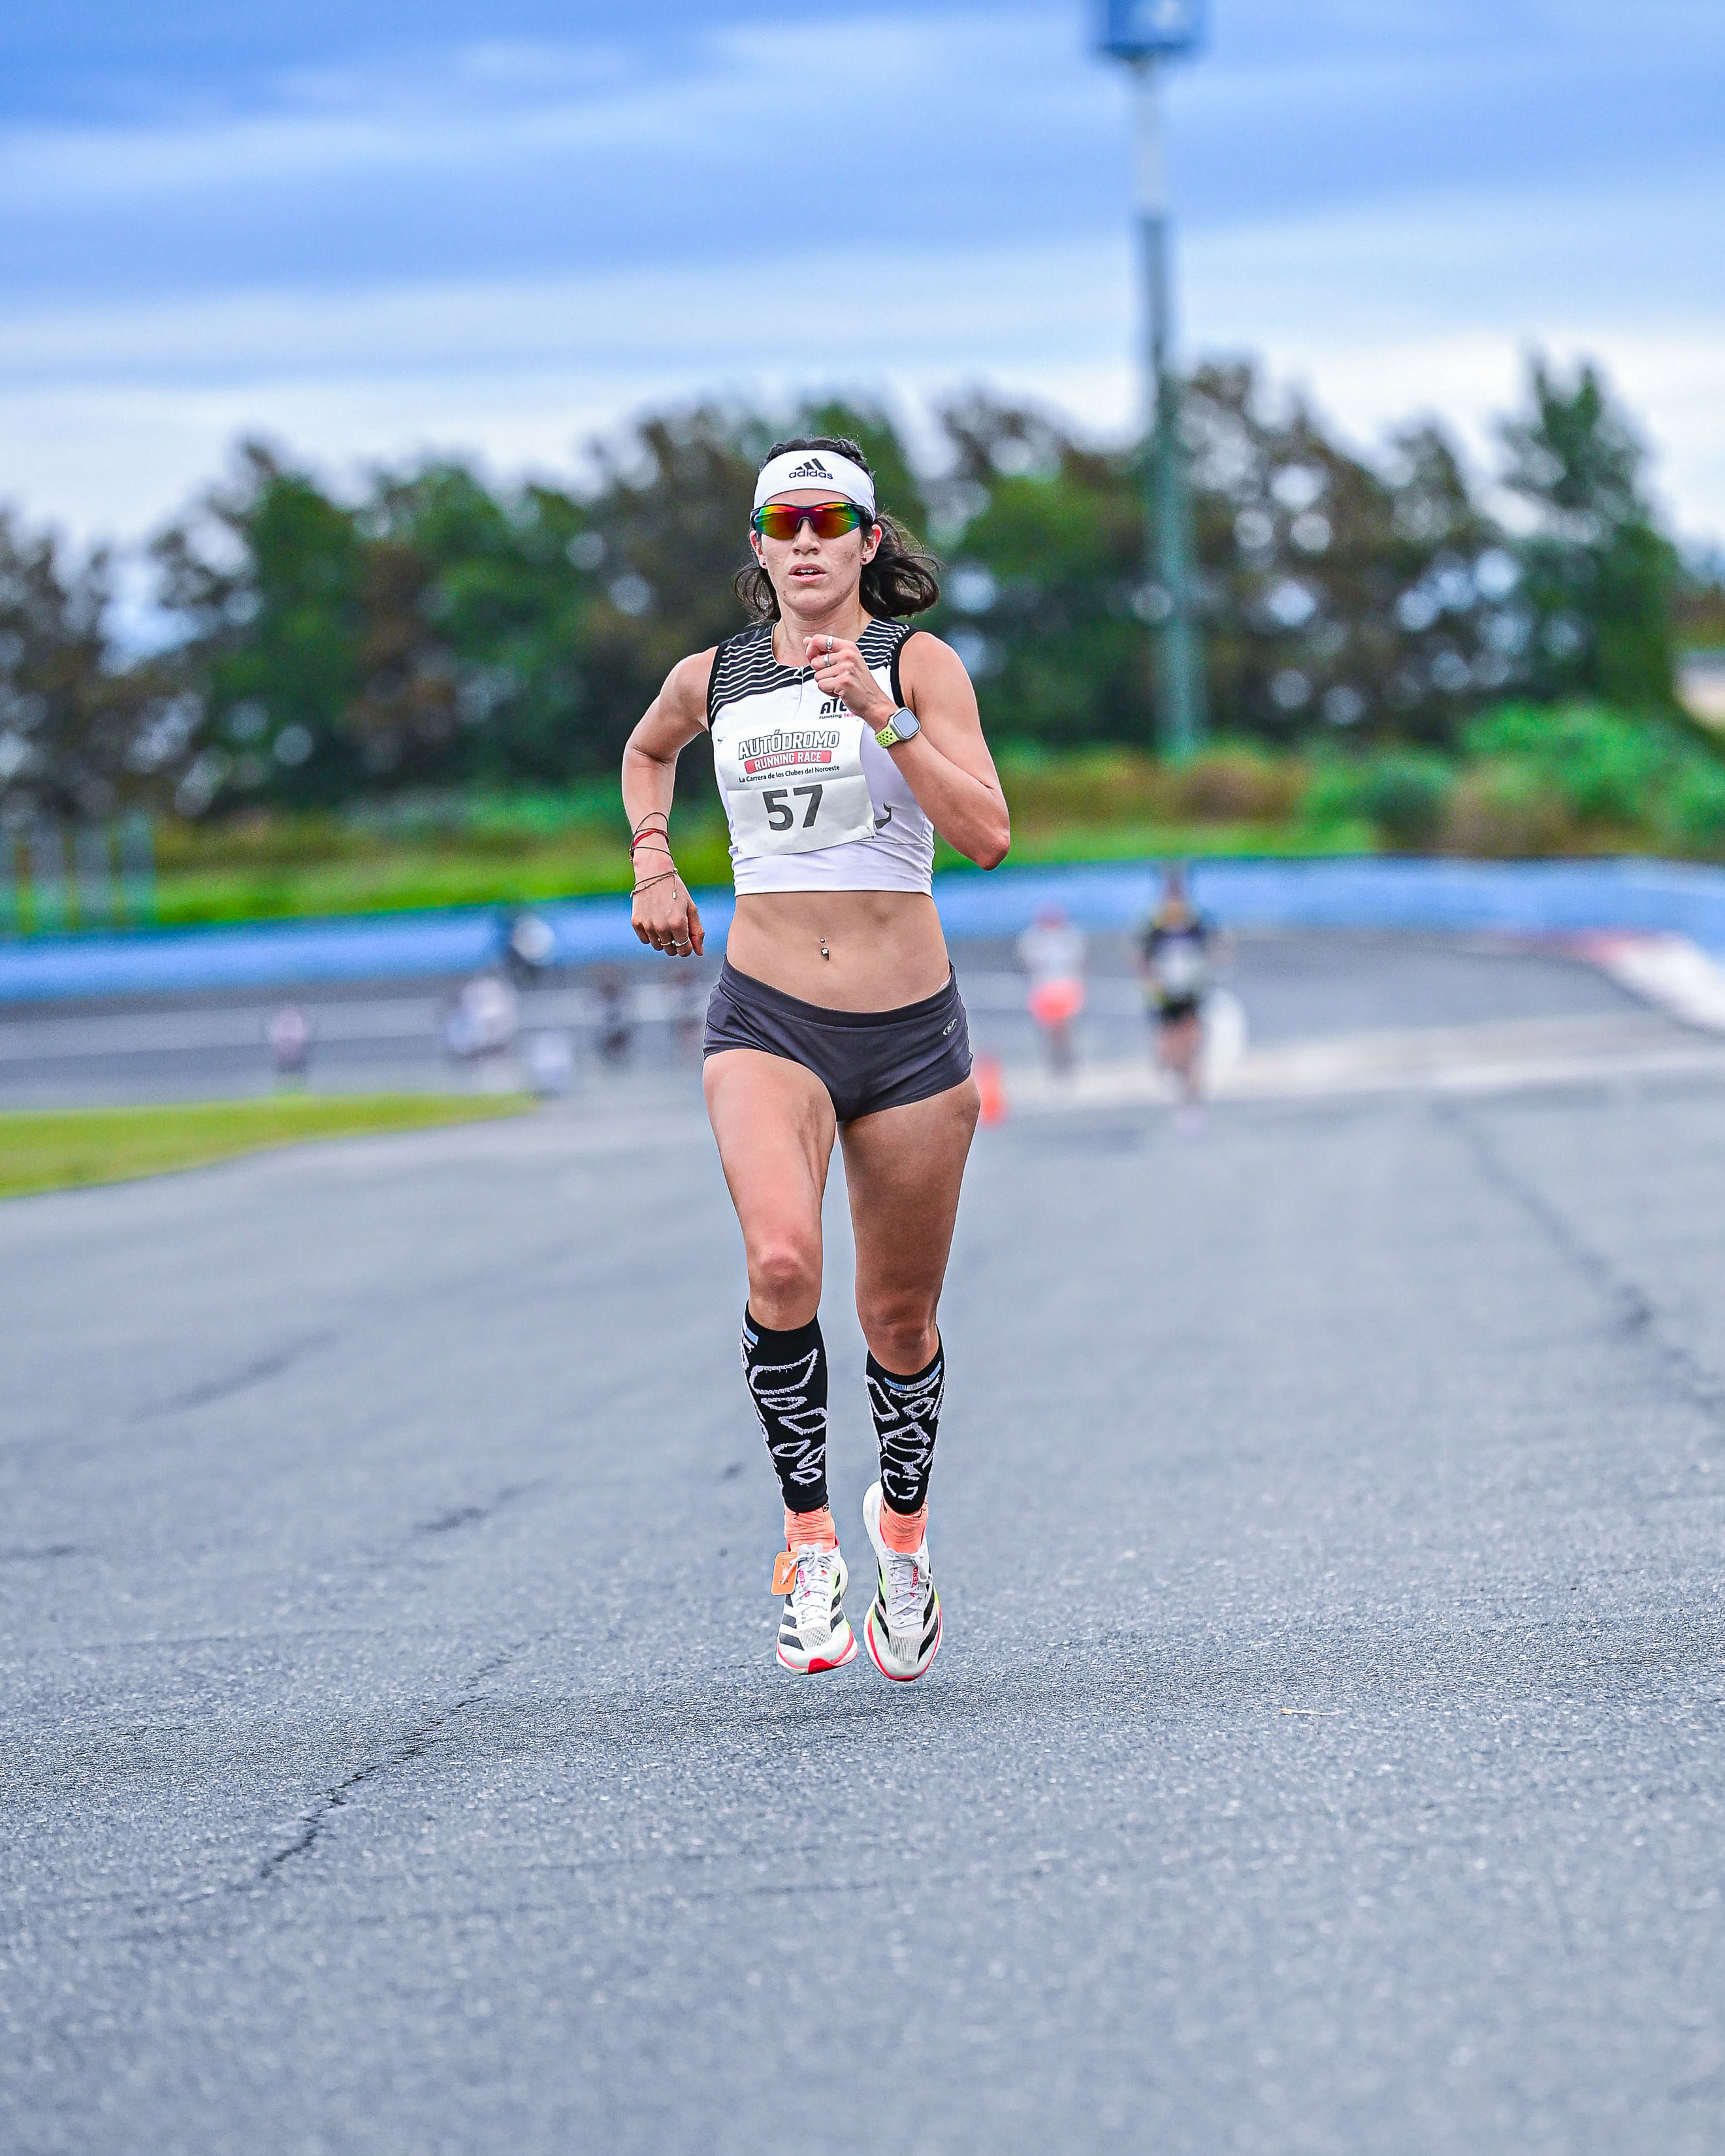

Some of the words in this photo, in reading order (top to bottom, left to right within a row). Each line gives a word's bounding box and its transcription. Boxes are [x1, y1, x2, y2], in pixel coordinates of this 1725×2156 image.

[788, 468, 833, 479] adidas
[738, 729, 840, 760] AUTÓDROMO
[754, 752, 795, 771] RUNNING
[798, 751, 822, 763] RACE
[762, 784, 824, 831] 57
